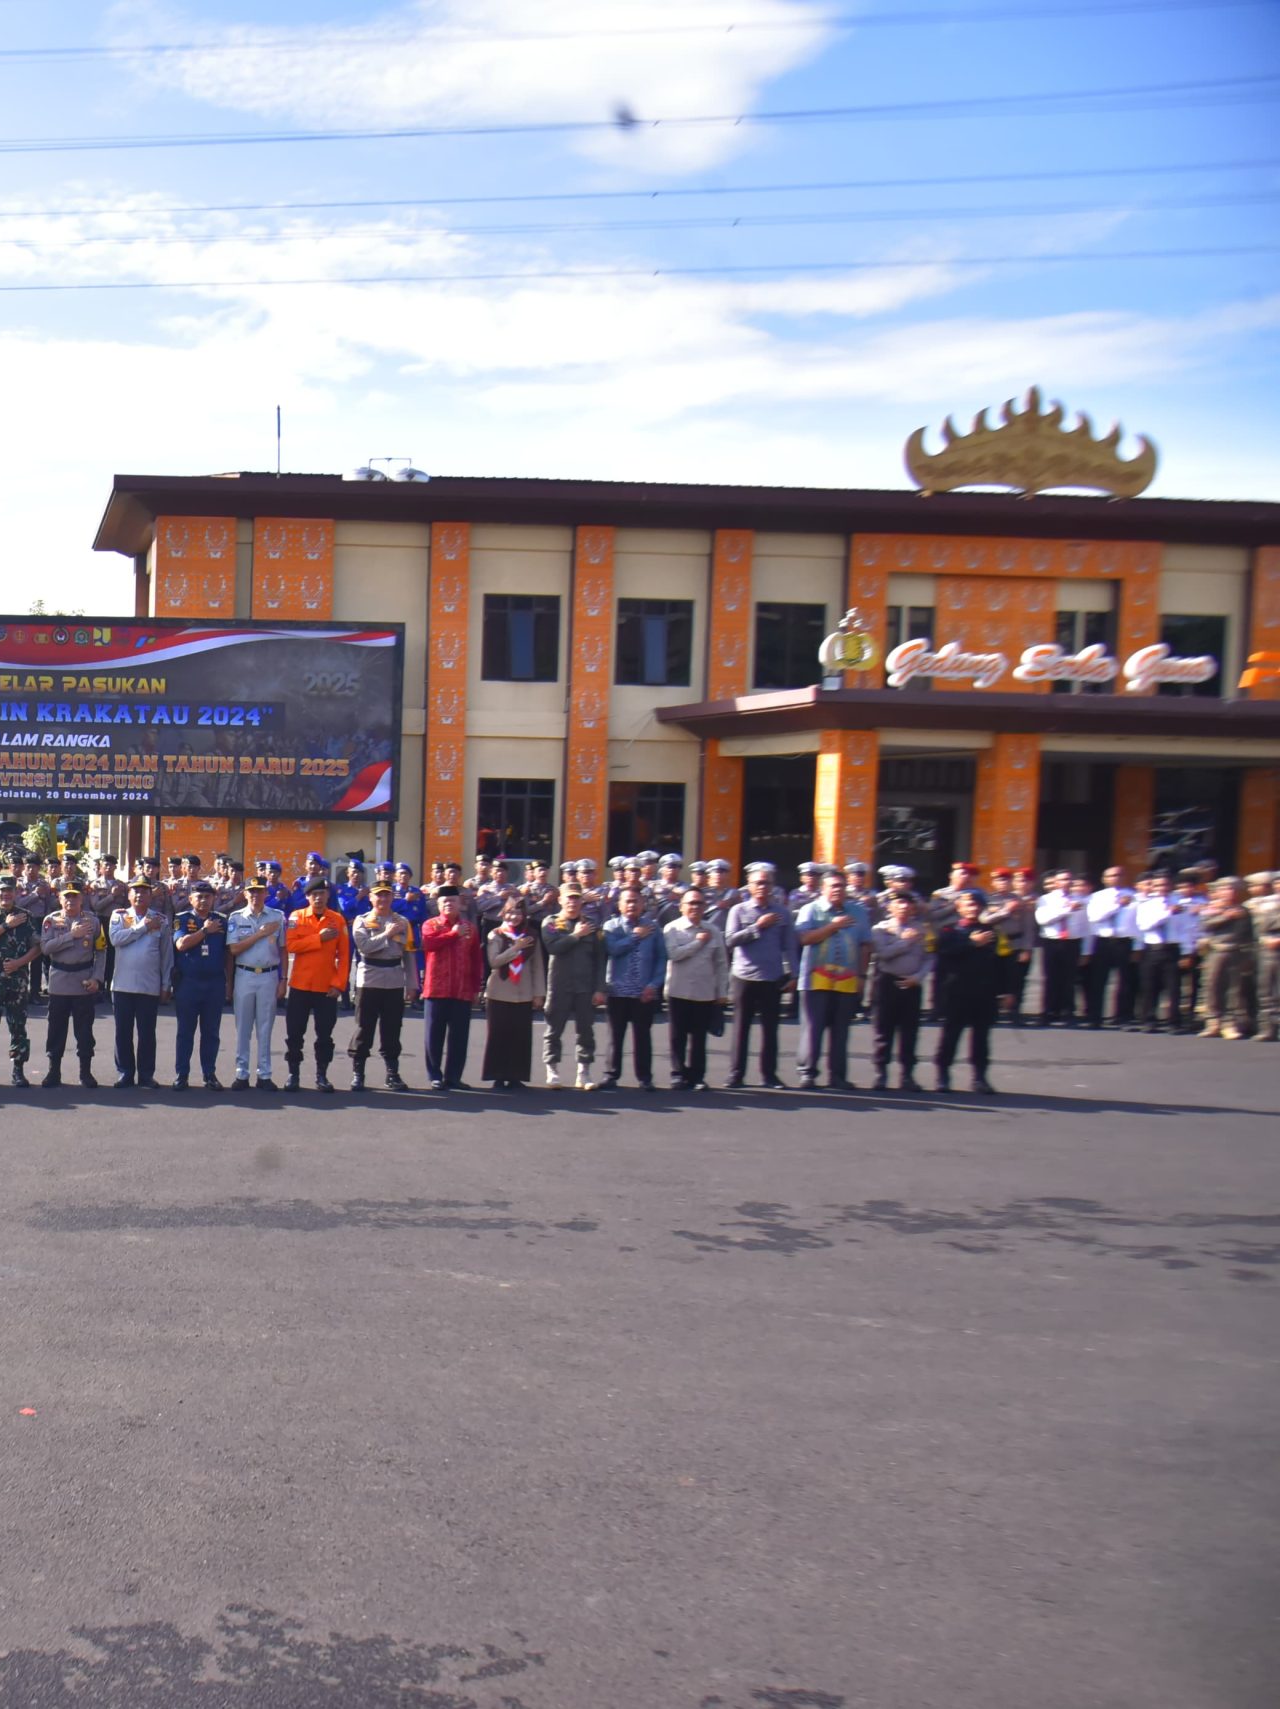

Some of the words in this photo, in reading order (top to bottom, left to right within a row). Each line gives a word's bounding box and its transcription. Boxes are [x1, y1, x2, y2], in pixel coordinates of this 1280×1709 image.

[885, 638, 1008, 688] Gedung
[61, 675, 166, 695] PASUKAN
[303, 672, 361, 696] 2025
[35, 703, 190, 725] KRAKATAU
[197, 706, 273, 726] 2024"
[41, 733, 111, 748] RANGKA
[60, 753, 110, 772] 2024
[114, 754, 159, 772] DAN
[163, 755, 234, 775] TAHUN
[239, 756, 296, 776] BARU
[299, 757, 350, 777] 2025
[58, 772, 155, 790] LAMPUNG
[46, 791, 59, 799] 20
[64, 790, 118, 800] Desember
[122, 791, 149, 801] 2024
